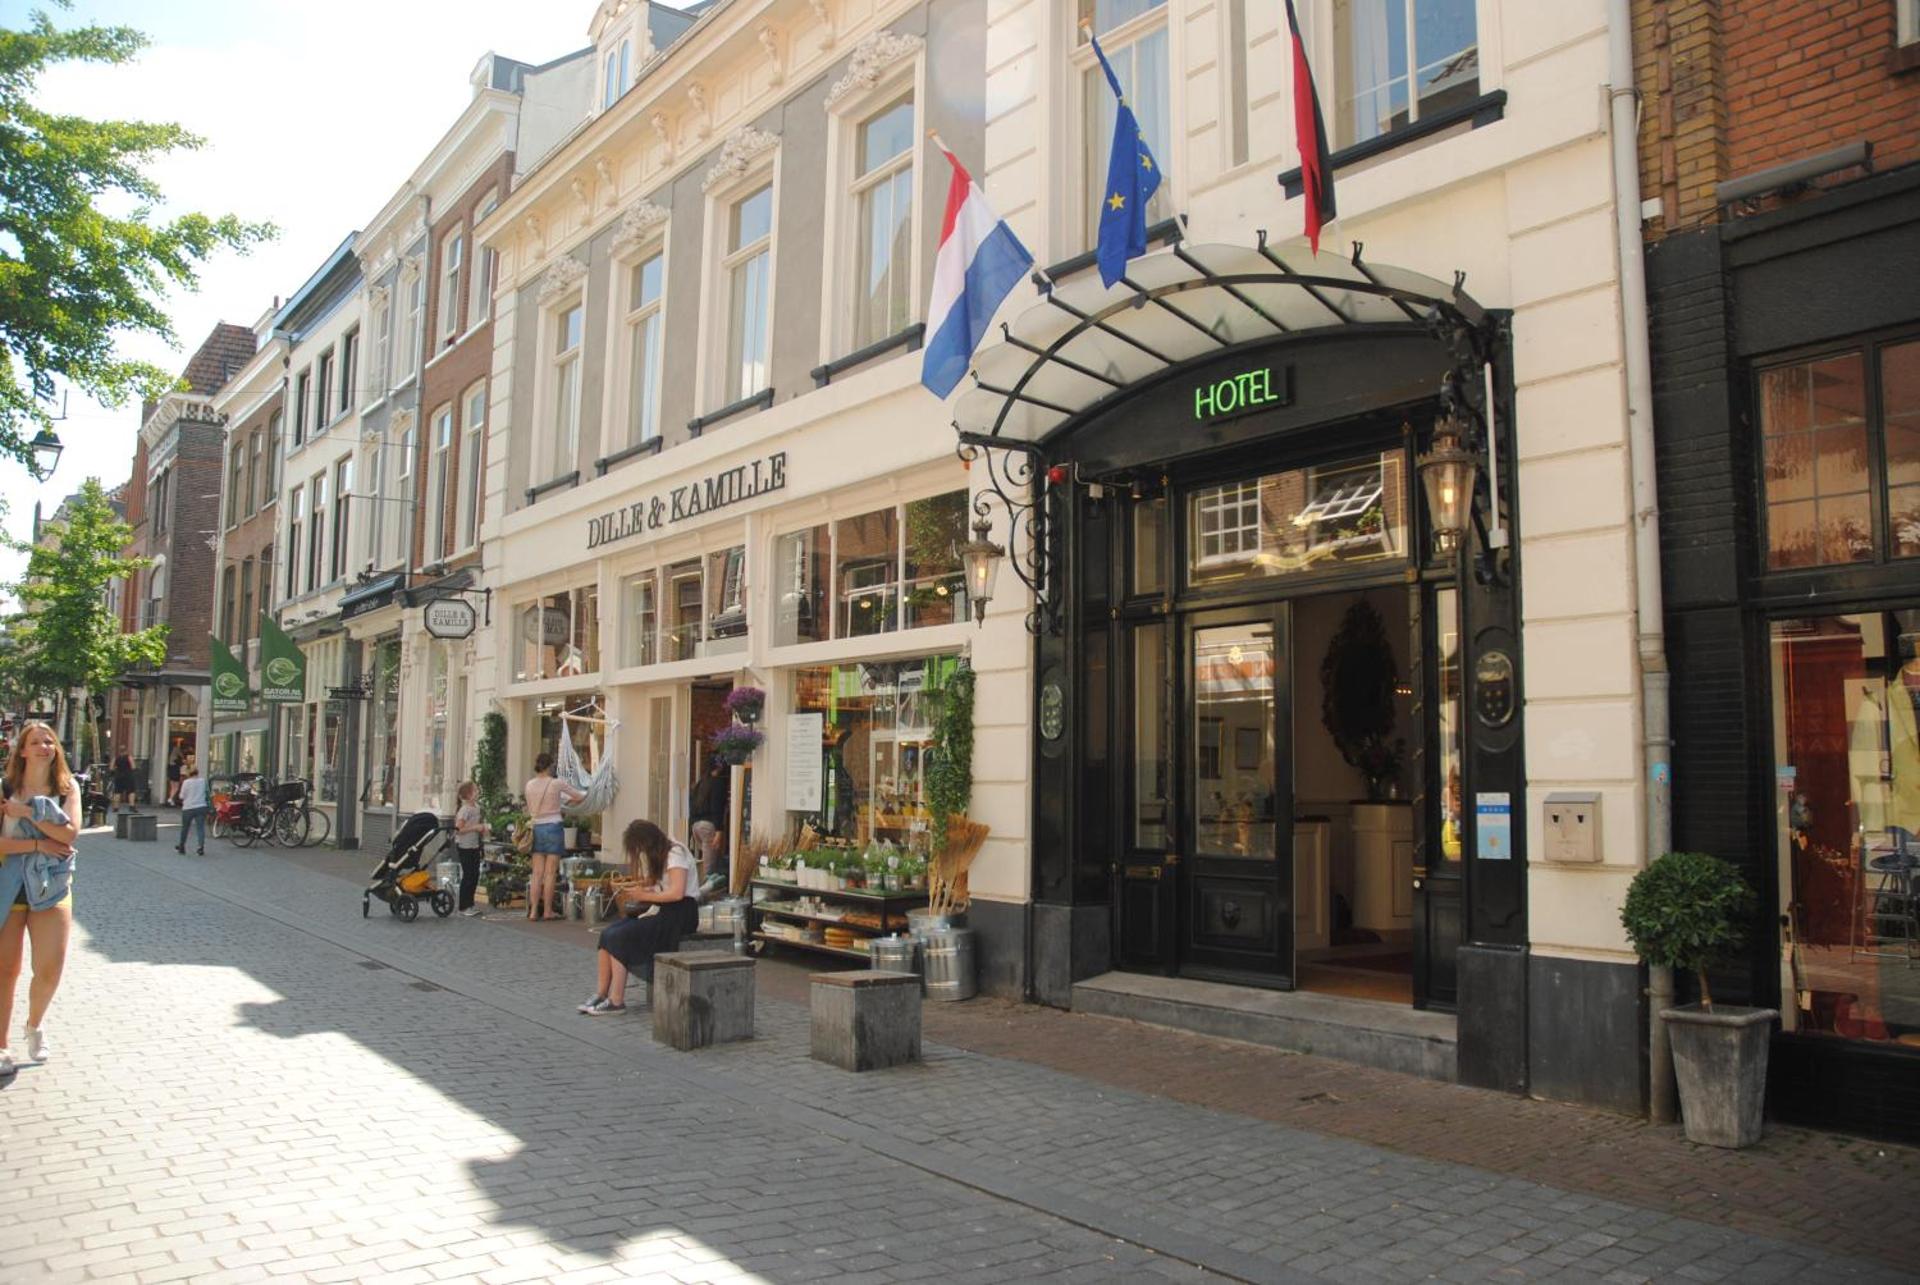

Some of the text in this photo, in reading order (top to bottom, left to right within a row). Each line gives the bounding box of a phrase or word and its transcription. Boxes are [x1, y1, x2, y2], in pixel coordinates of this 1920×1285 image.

[1195, 367, 1279, 419] HOTEL
[586, 451, 786, 550] DILLE & KAMILLE
